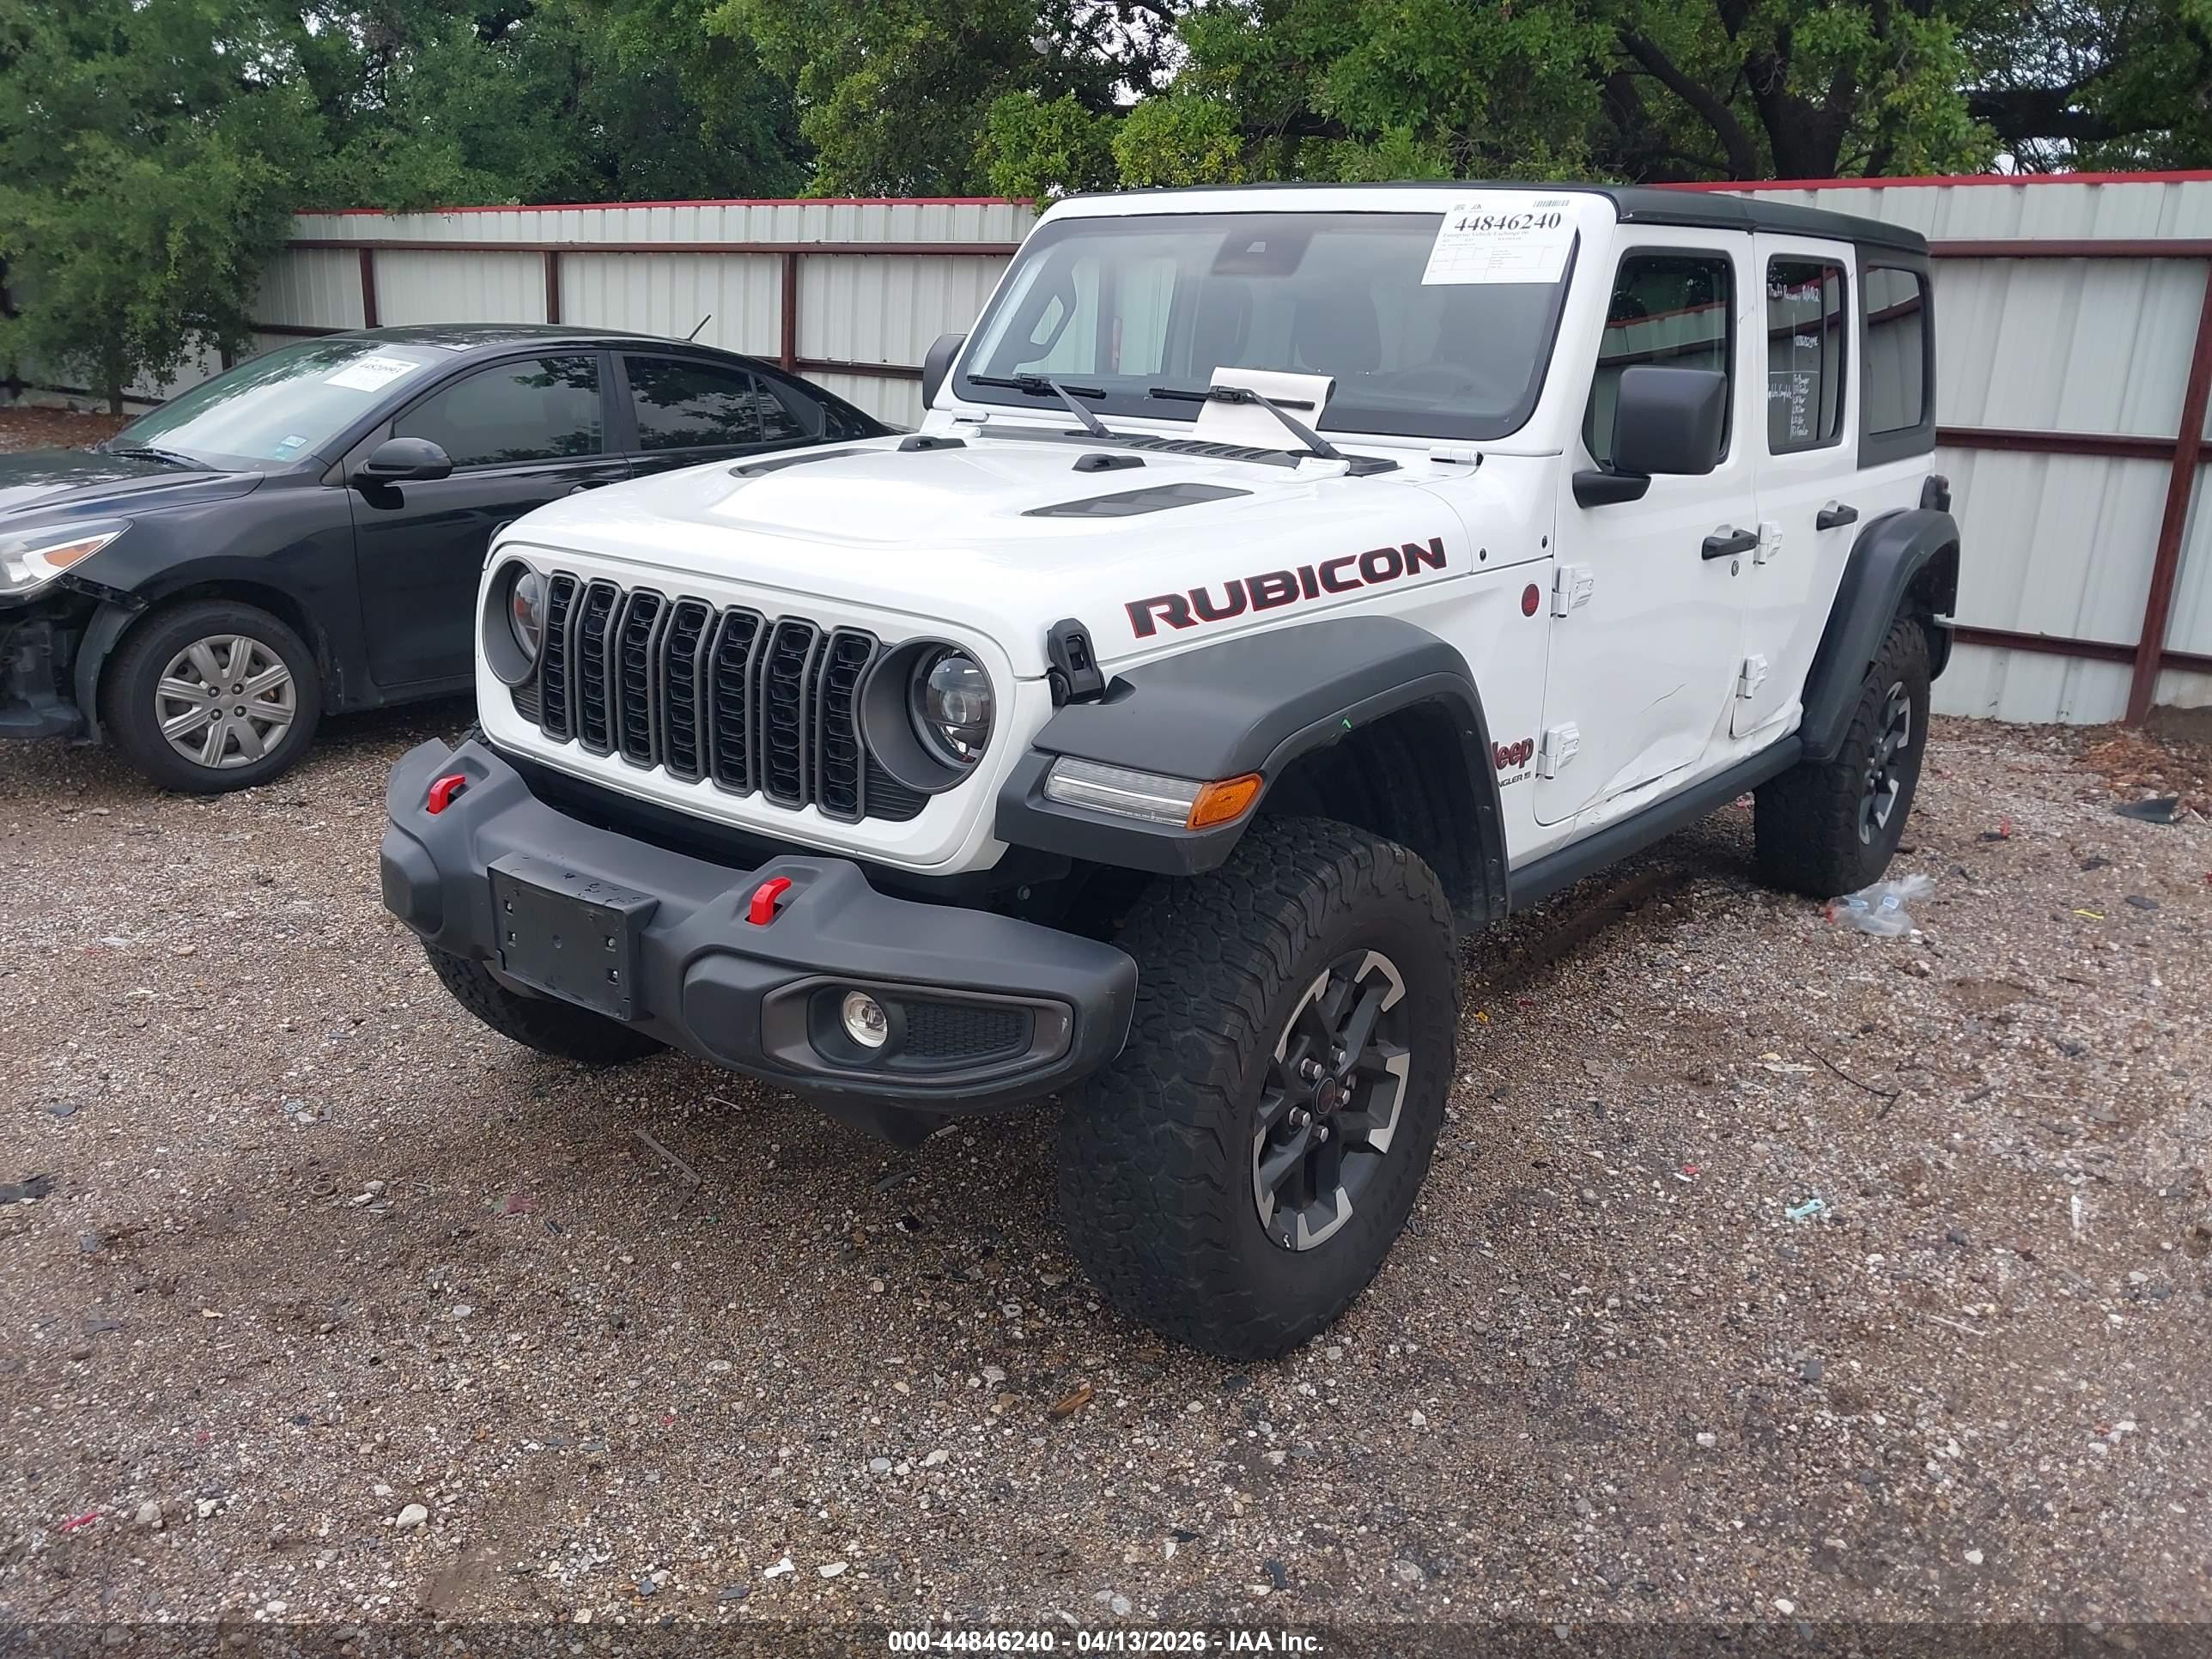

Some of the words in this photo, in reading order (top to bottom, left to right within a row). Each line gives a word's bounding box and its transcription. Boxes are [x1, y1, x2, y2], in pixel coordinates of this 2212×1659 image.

[1454, 212, 1562, 231] 44846240
[1767, 283, 1783, 298] Theft
[1124, 537, 1447, 639] RUBICON
[1498, 774, 1523, 788] NGLER
